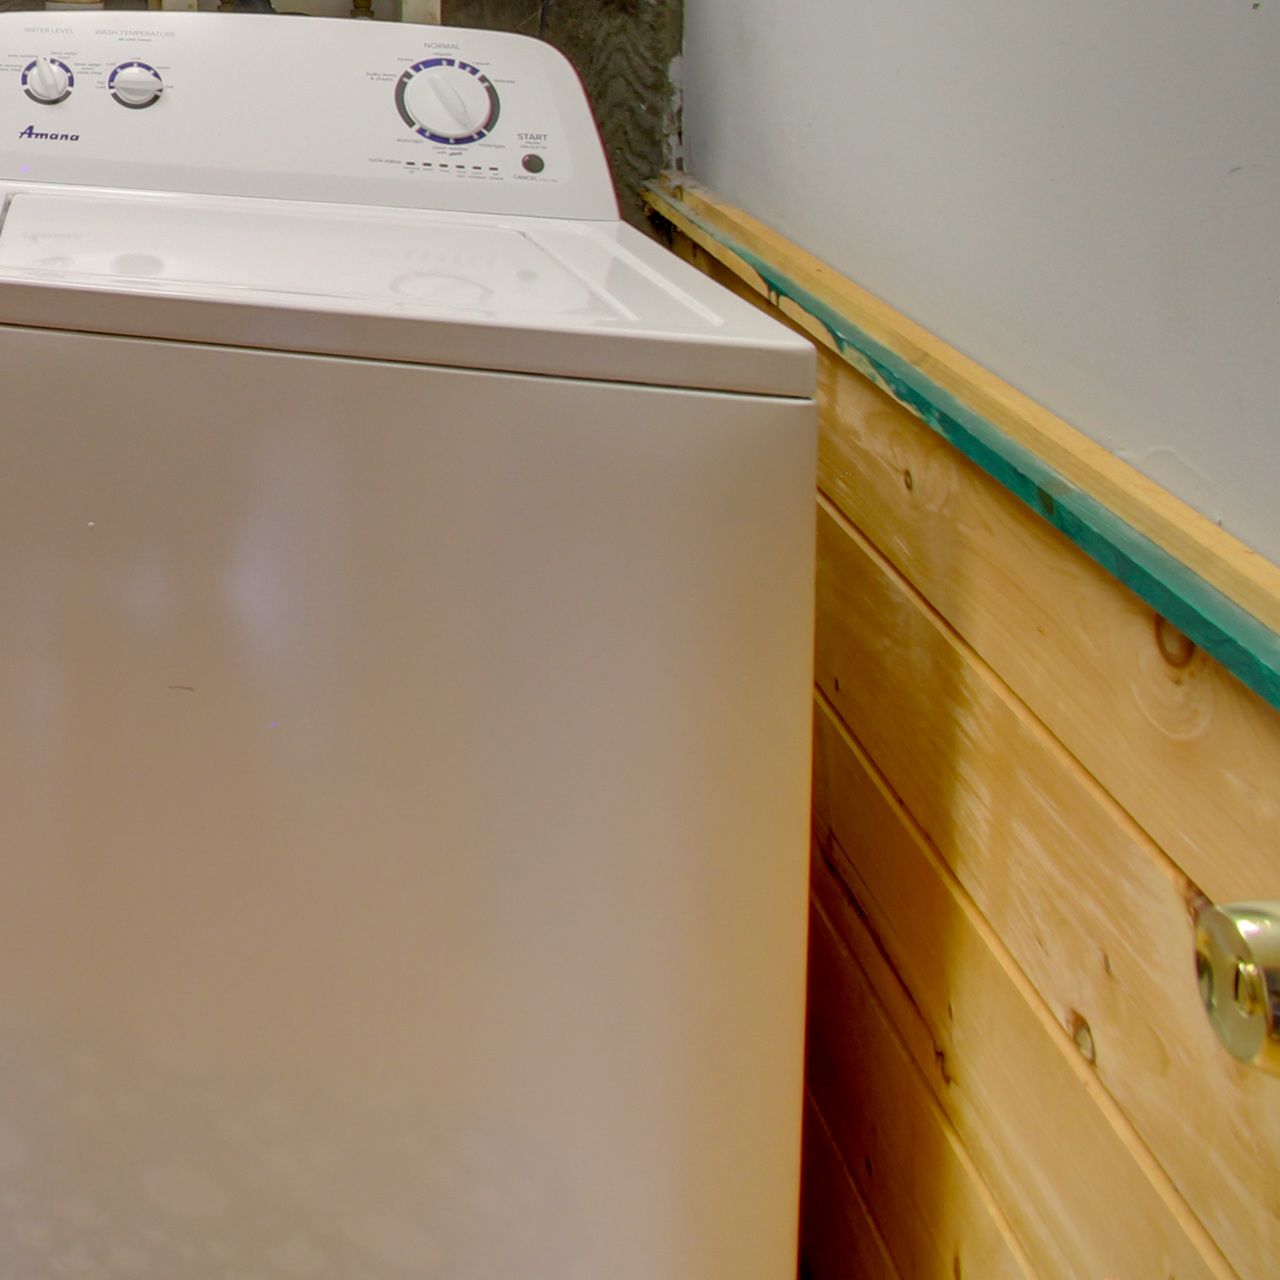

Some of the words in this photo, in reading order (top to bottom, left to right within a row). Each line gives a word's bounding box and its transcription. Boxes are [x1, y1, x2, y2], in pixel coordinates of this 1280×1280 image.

[424, 42, 460, 50] NORMAL
[19, 125, 80, 141] Amana
[517, 132, 548, 141] START
